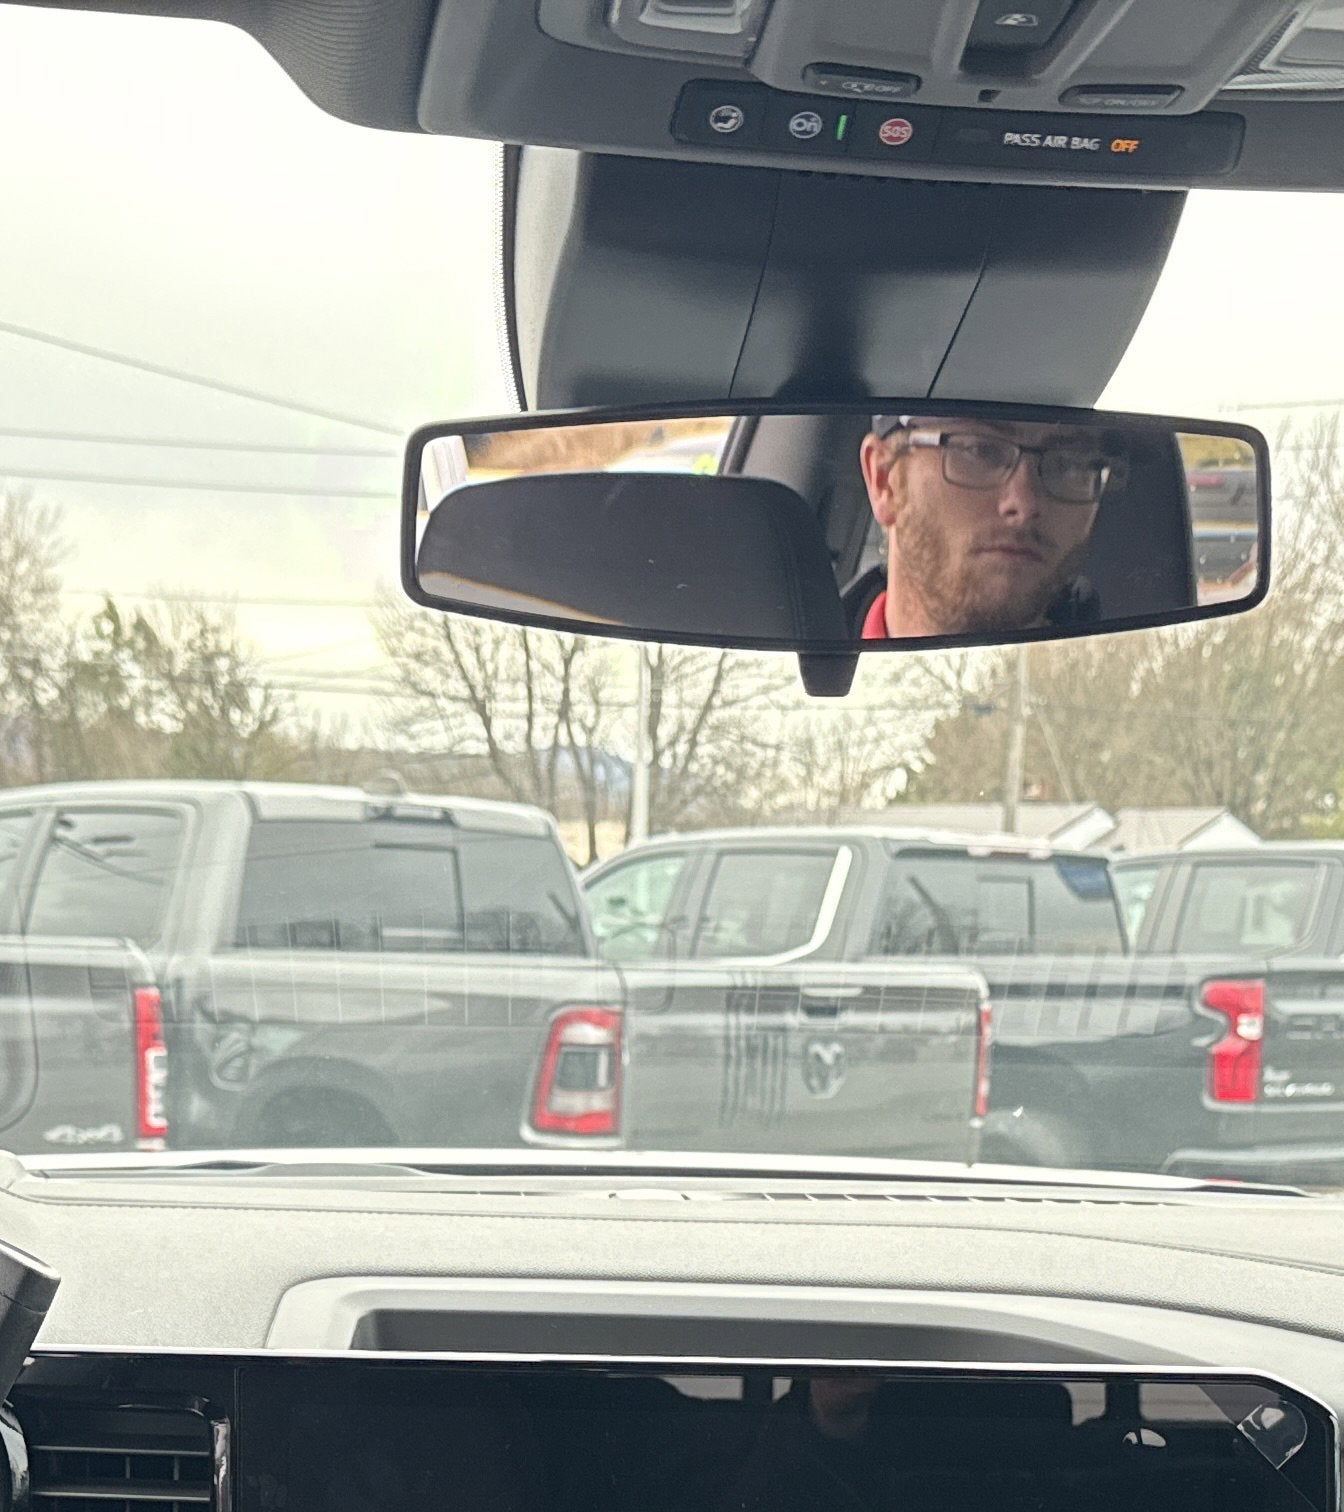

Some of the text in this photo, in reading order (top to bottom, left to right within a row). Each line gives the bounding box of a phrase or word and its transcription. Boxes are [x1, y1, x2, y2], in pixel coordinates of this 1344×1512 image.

[880, 125, 910, 138] SOS
[1003, 132, 1140, 153] PASS AIR BAG OFF
